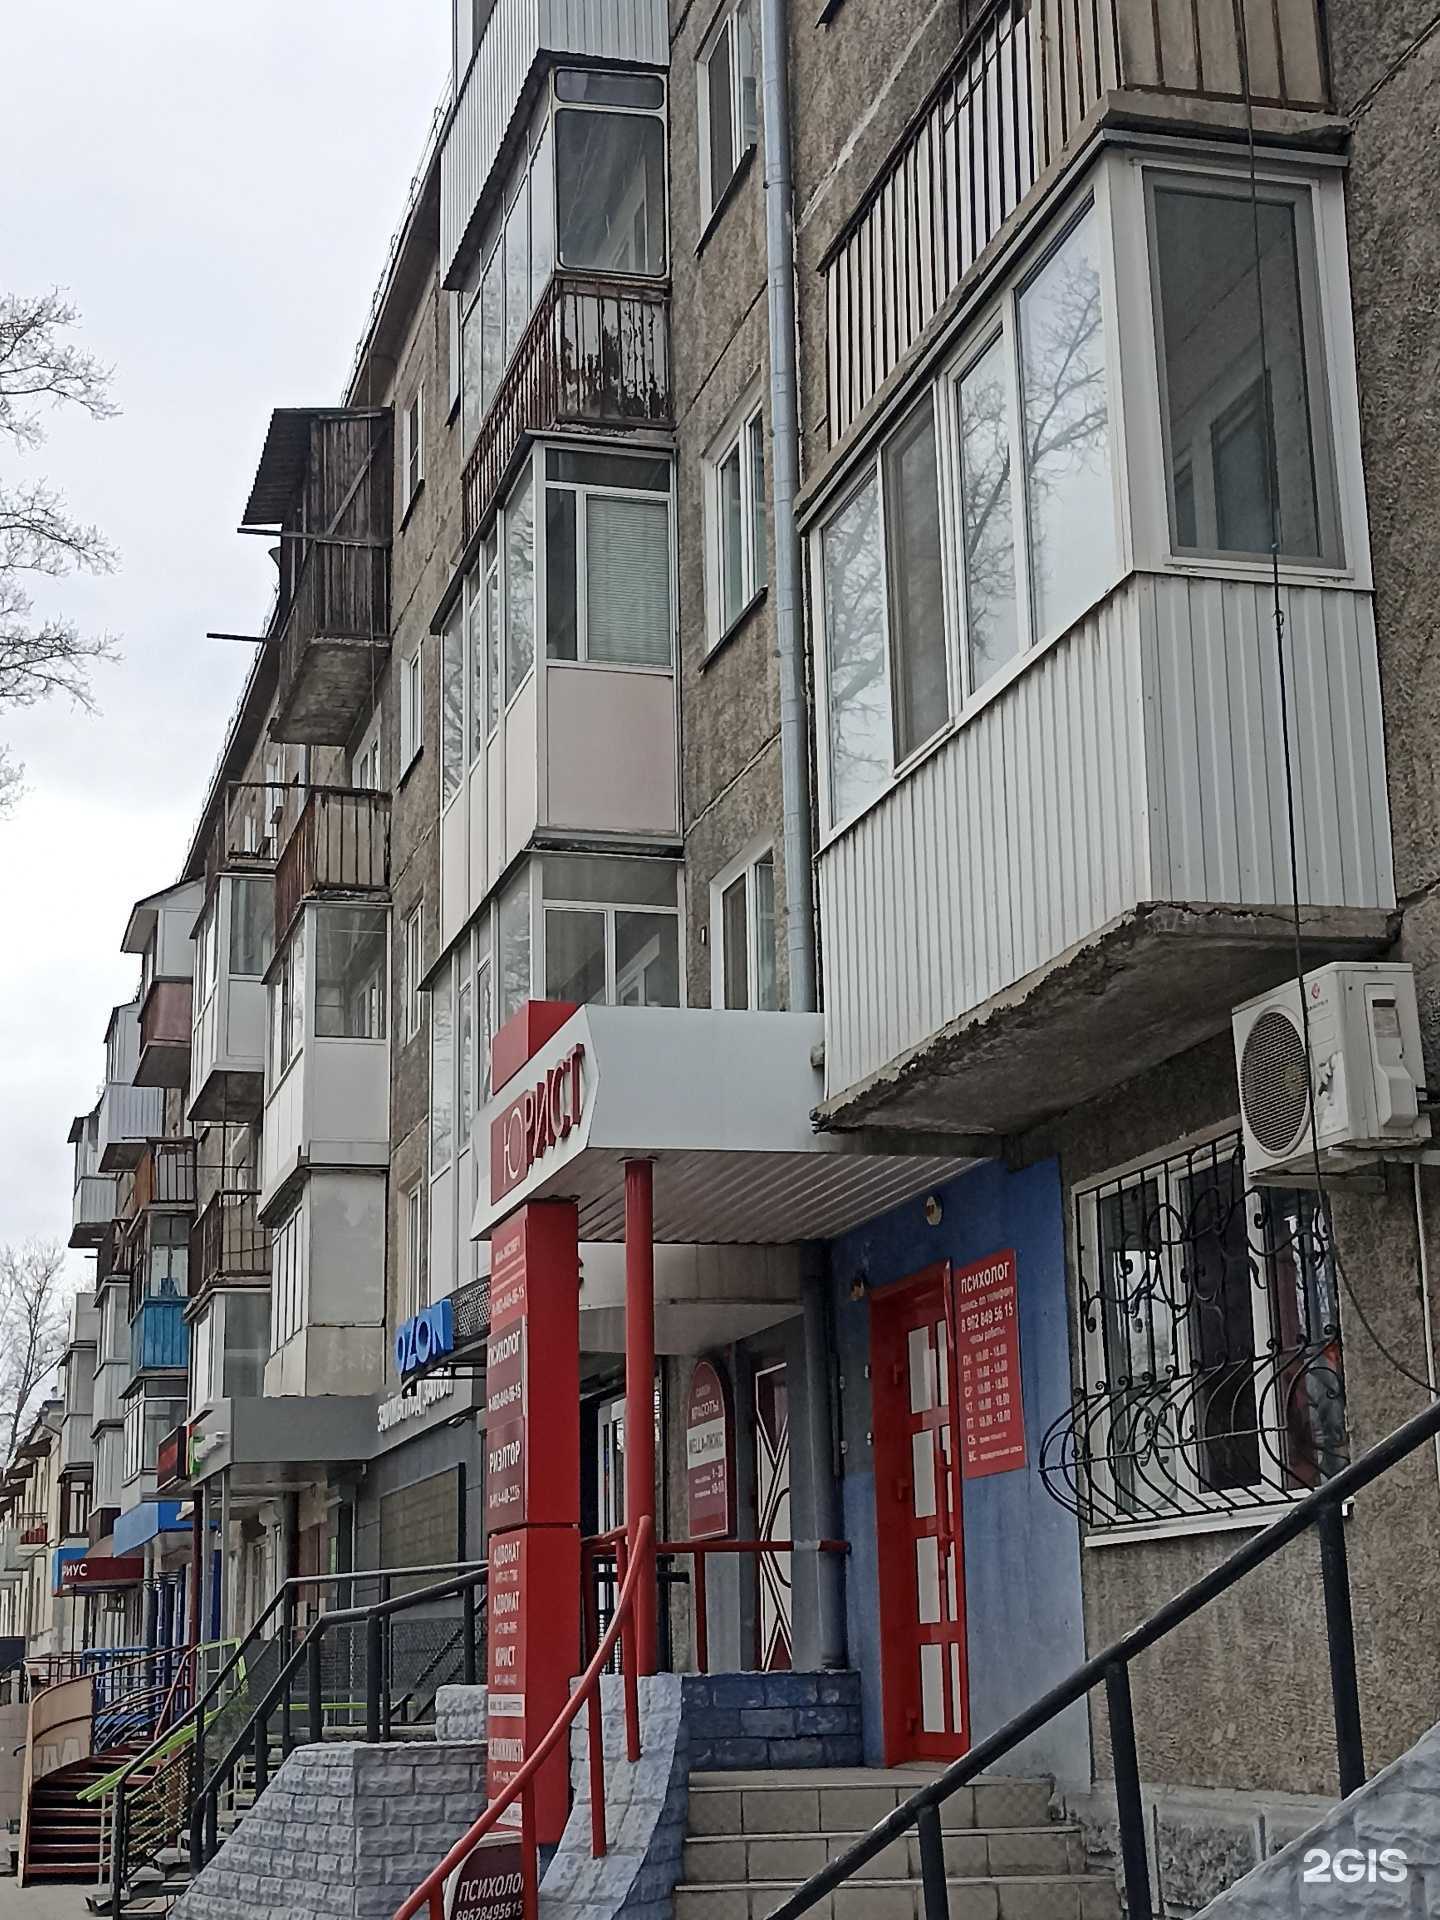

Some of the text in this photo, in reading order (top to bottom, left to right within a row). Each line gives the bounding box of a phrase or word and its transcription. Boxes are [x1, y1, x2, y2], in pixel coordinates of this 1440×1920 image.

[504, 1043, 585, 1184] ЮРИСТ
[961, 1262, 1010, 1294] ПСИХОЛОГ
[961, 1319, 966, 1333] 8
[994, 1306, 1003, 1321] 56
[1004, 1301, 1013, 1316] 15
[395, 1298, 454, 1376] OZON
[487, 1330, 521, 1369] ПСИХОЛОГ
[489, 1440, 521, 1474] РИЭЛТОР
[493, 1541, 520, 1568] АДВОКАТ
[493, 1591, 520, 1616] АДВОКАТ
[495, 1645, 516, 1667] ЮРИСТ
[458, 1872, 524, 1903] ПСИХОЛО
